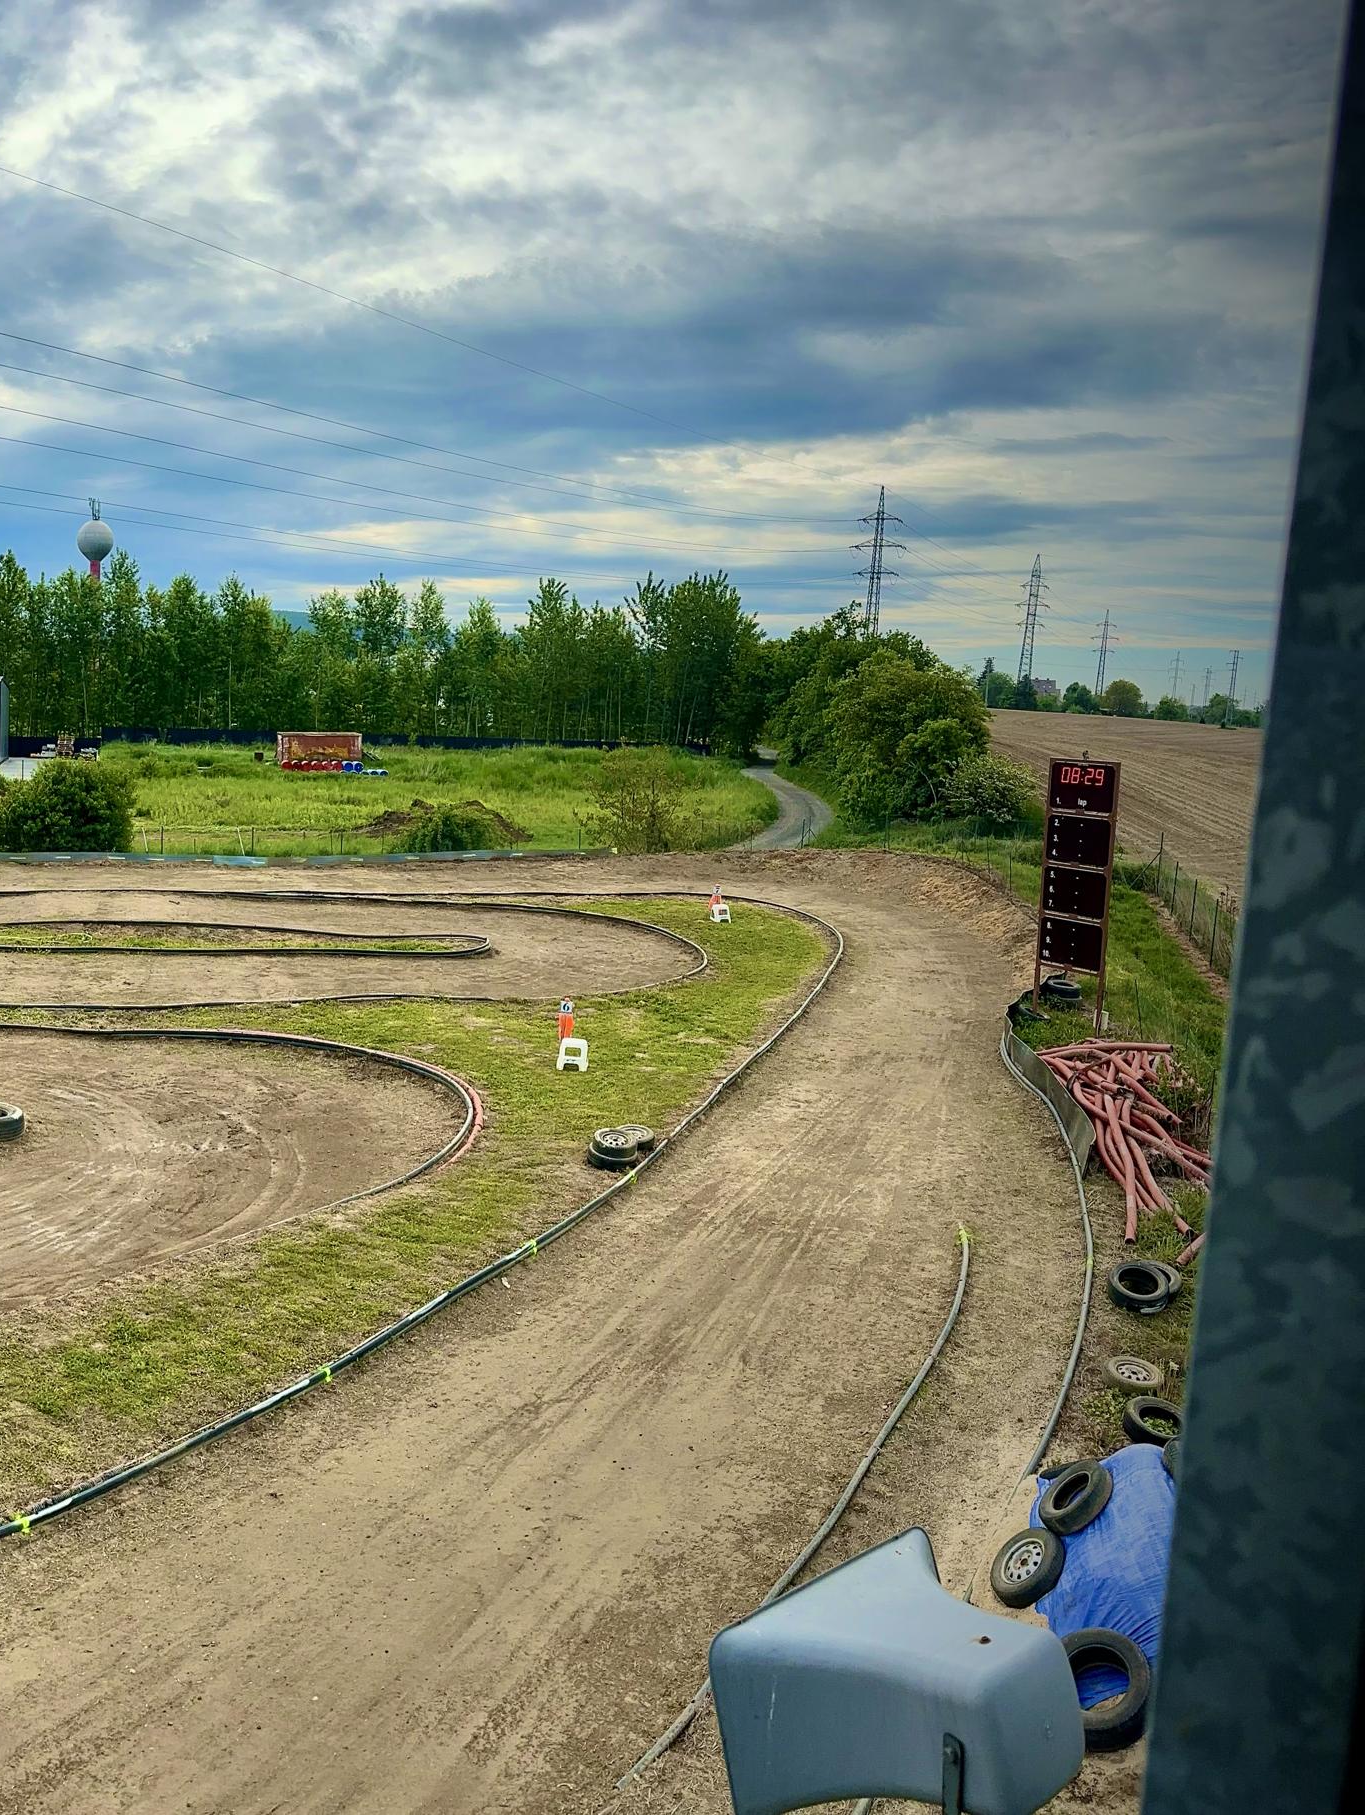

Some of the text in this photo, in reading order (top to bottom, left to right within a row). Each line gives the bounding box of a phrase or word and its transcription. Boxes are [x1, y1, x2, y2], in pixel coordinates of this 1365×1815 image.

[1061, 767, 1104, 785] 08:29
[1056, 797, 1087, 807] 1. lap
[563, 1002, 570, 1012] 6
